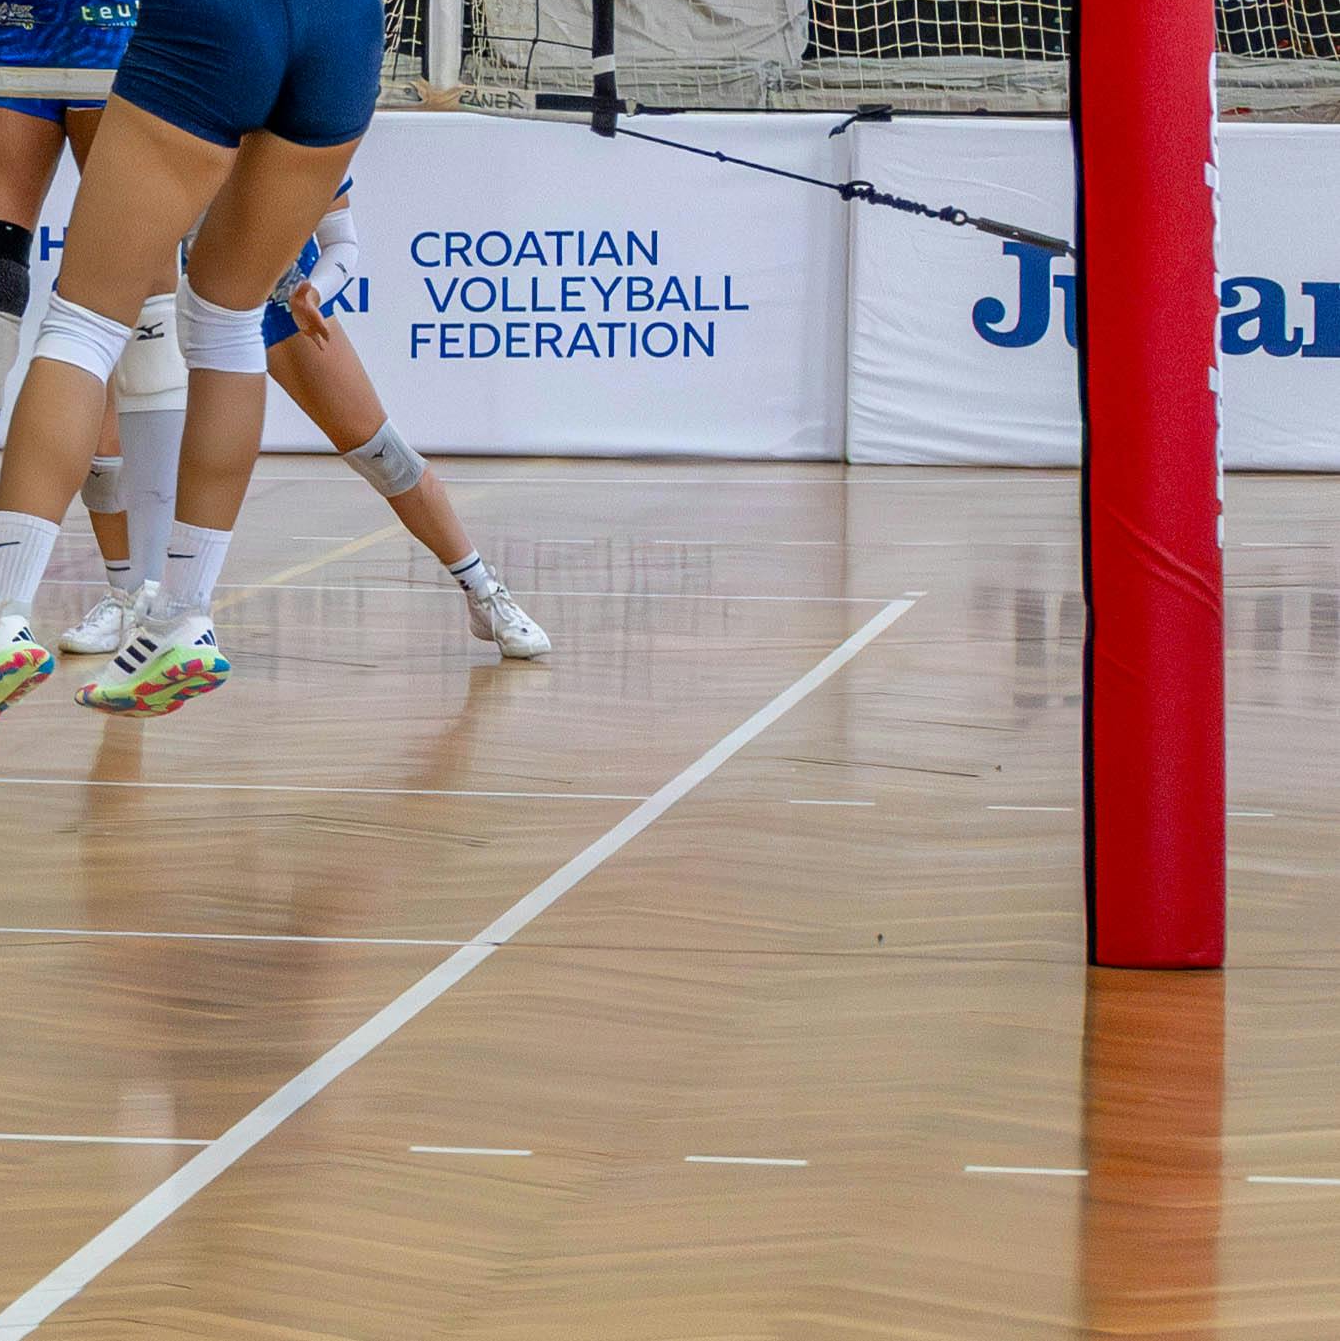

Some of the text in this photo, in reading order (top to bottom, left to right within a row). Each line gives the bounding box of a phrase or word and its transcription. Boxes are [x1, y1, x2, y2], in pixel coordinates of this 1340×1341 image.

[410, 230, 658, 268] CROATIAN
[424, 274, 750, 313] VOLLEYBALL
[410, 321, 715, 359] FEDERATION
